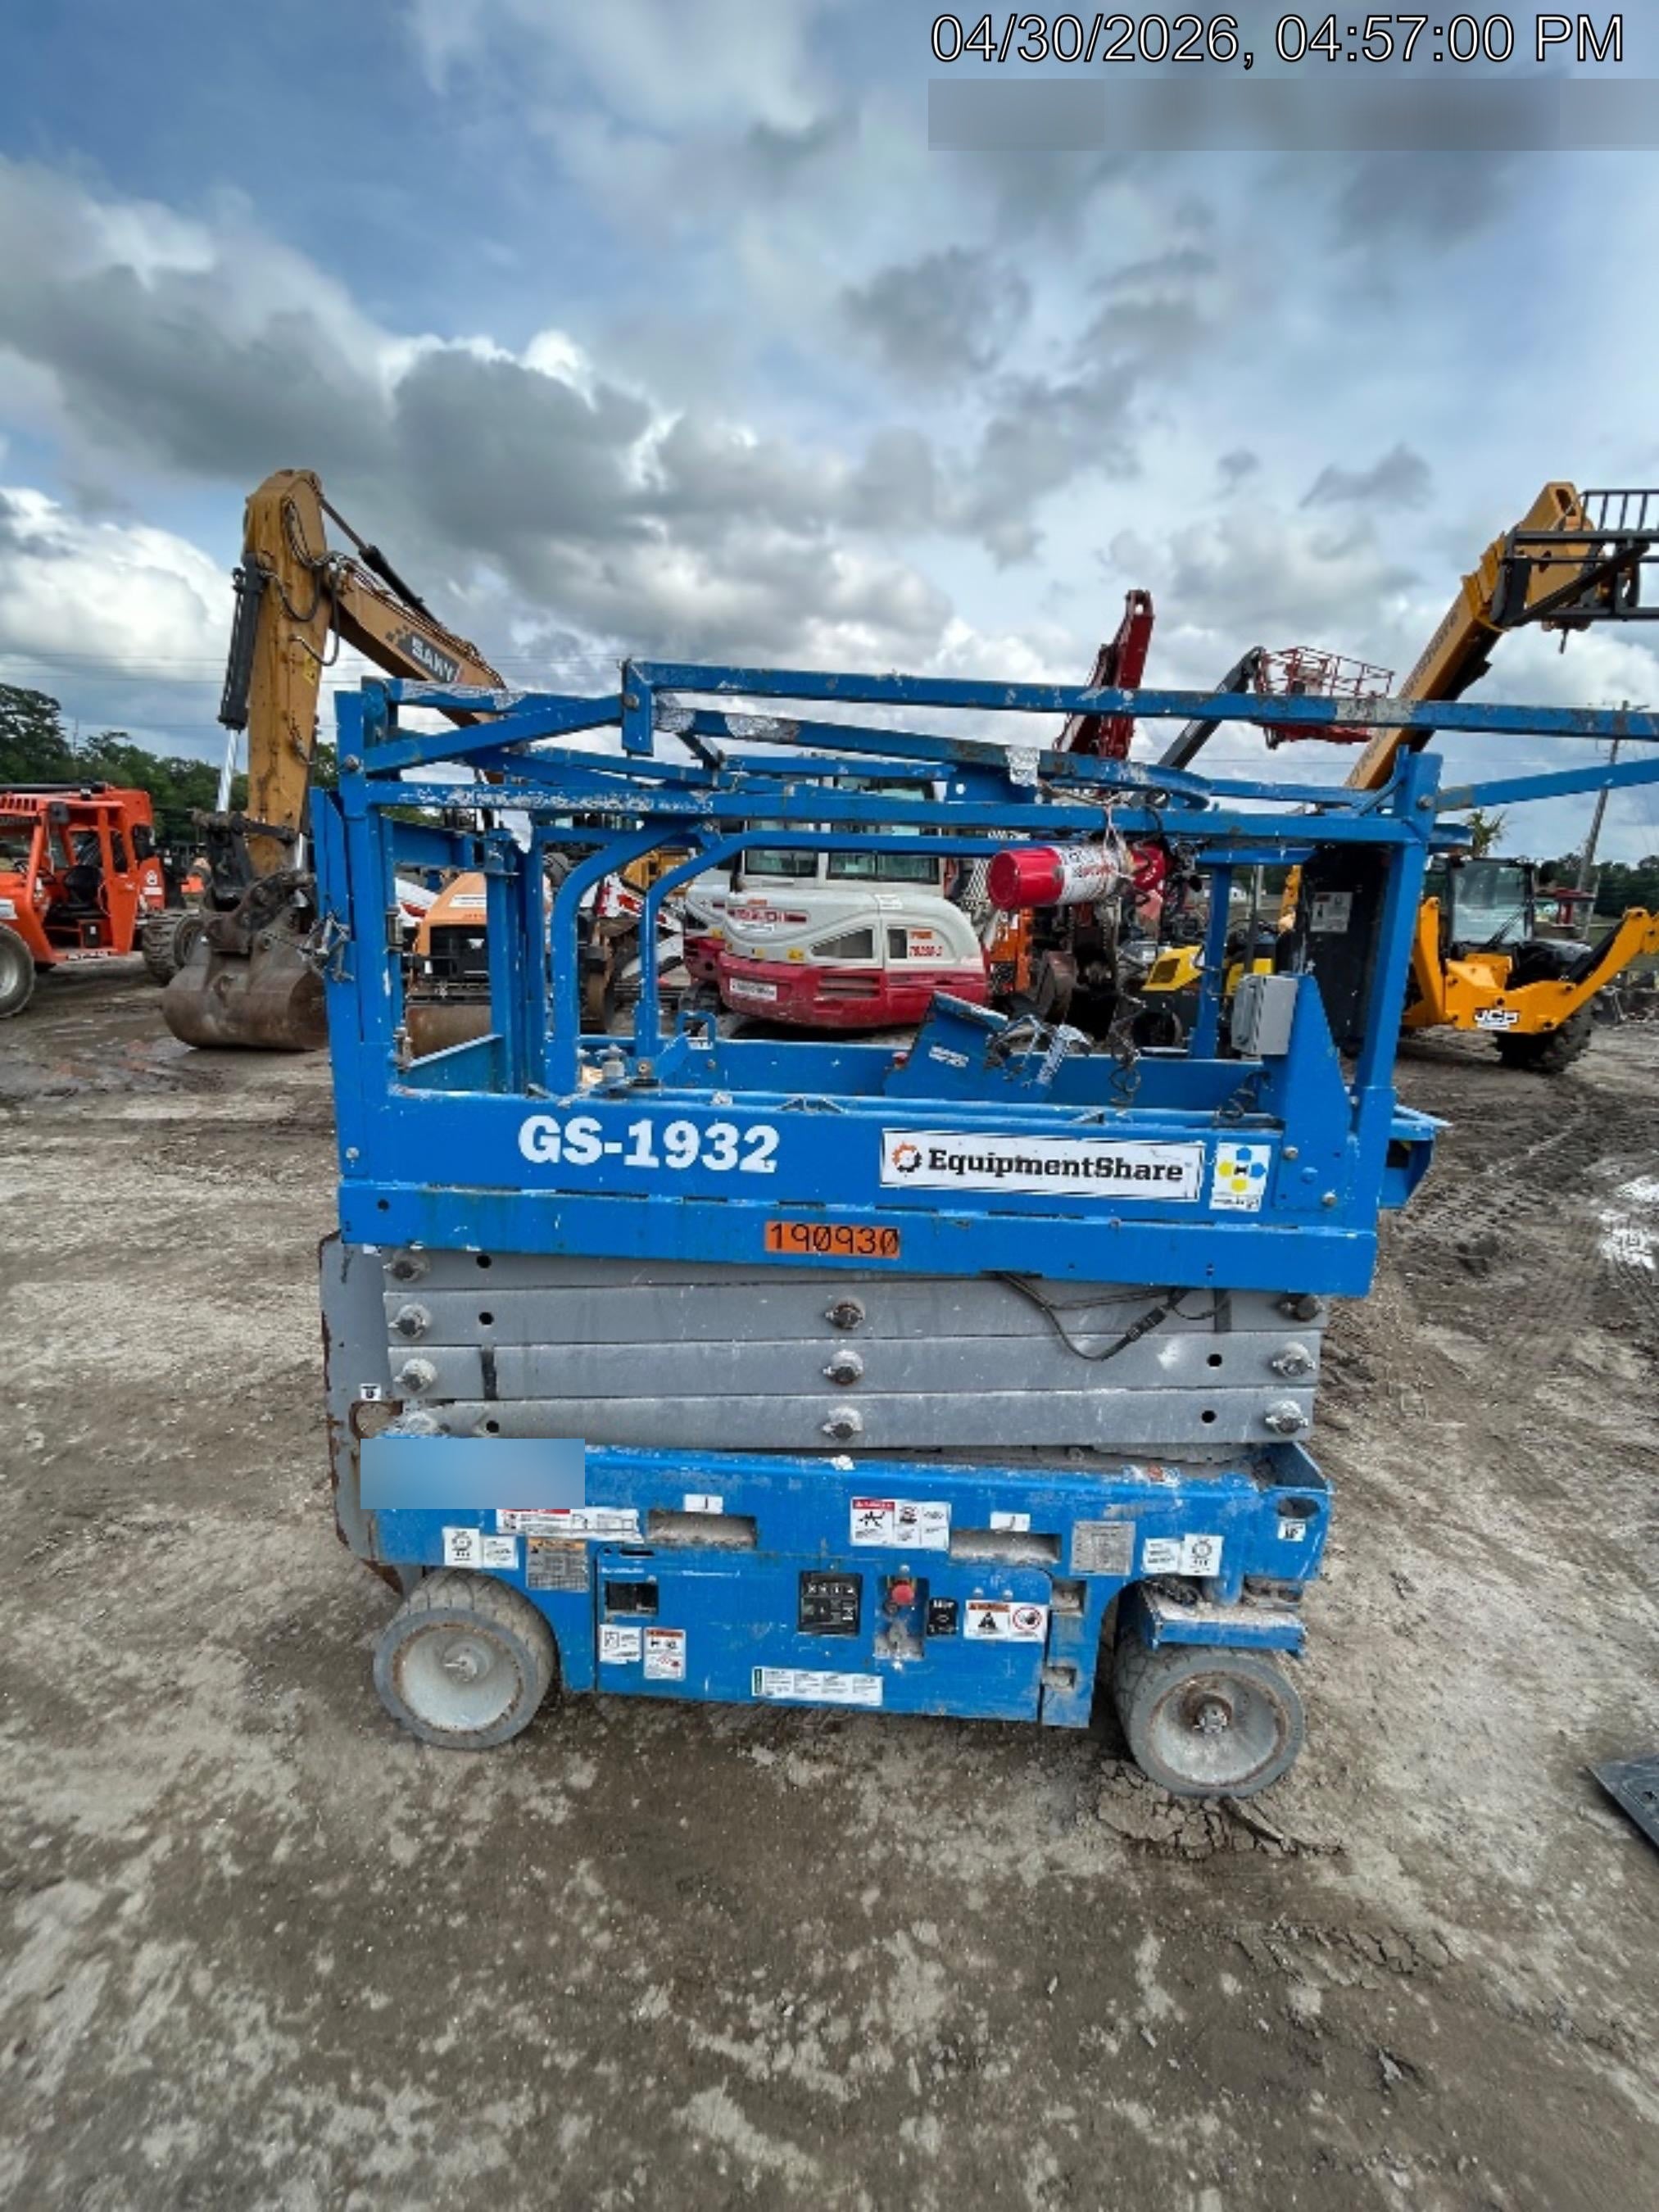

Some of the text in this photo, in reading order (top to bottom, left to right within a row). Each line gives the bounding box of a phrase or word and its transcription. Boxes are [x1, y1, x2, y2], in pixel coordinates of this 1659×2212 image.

[411, 636, 454, 682] SANY
[518, 1114, 779, 1173] GS-1932
[927, 1149, 1184, 1182] EquipmentShare
[770, 1222, 900, 1257] 190930
